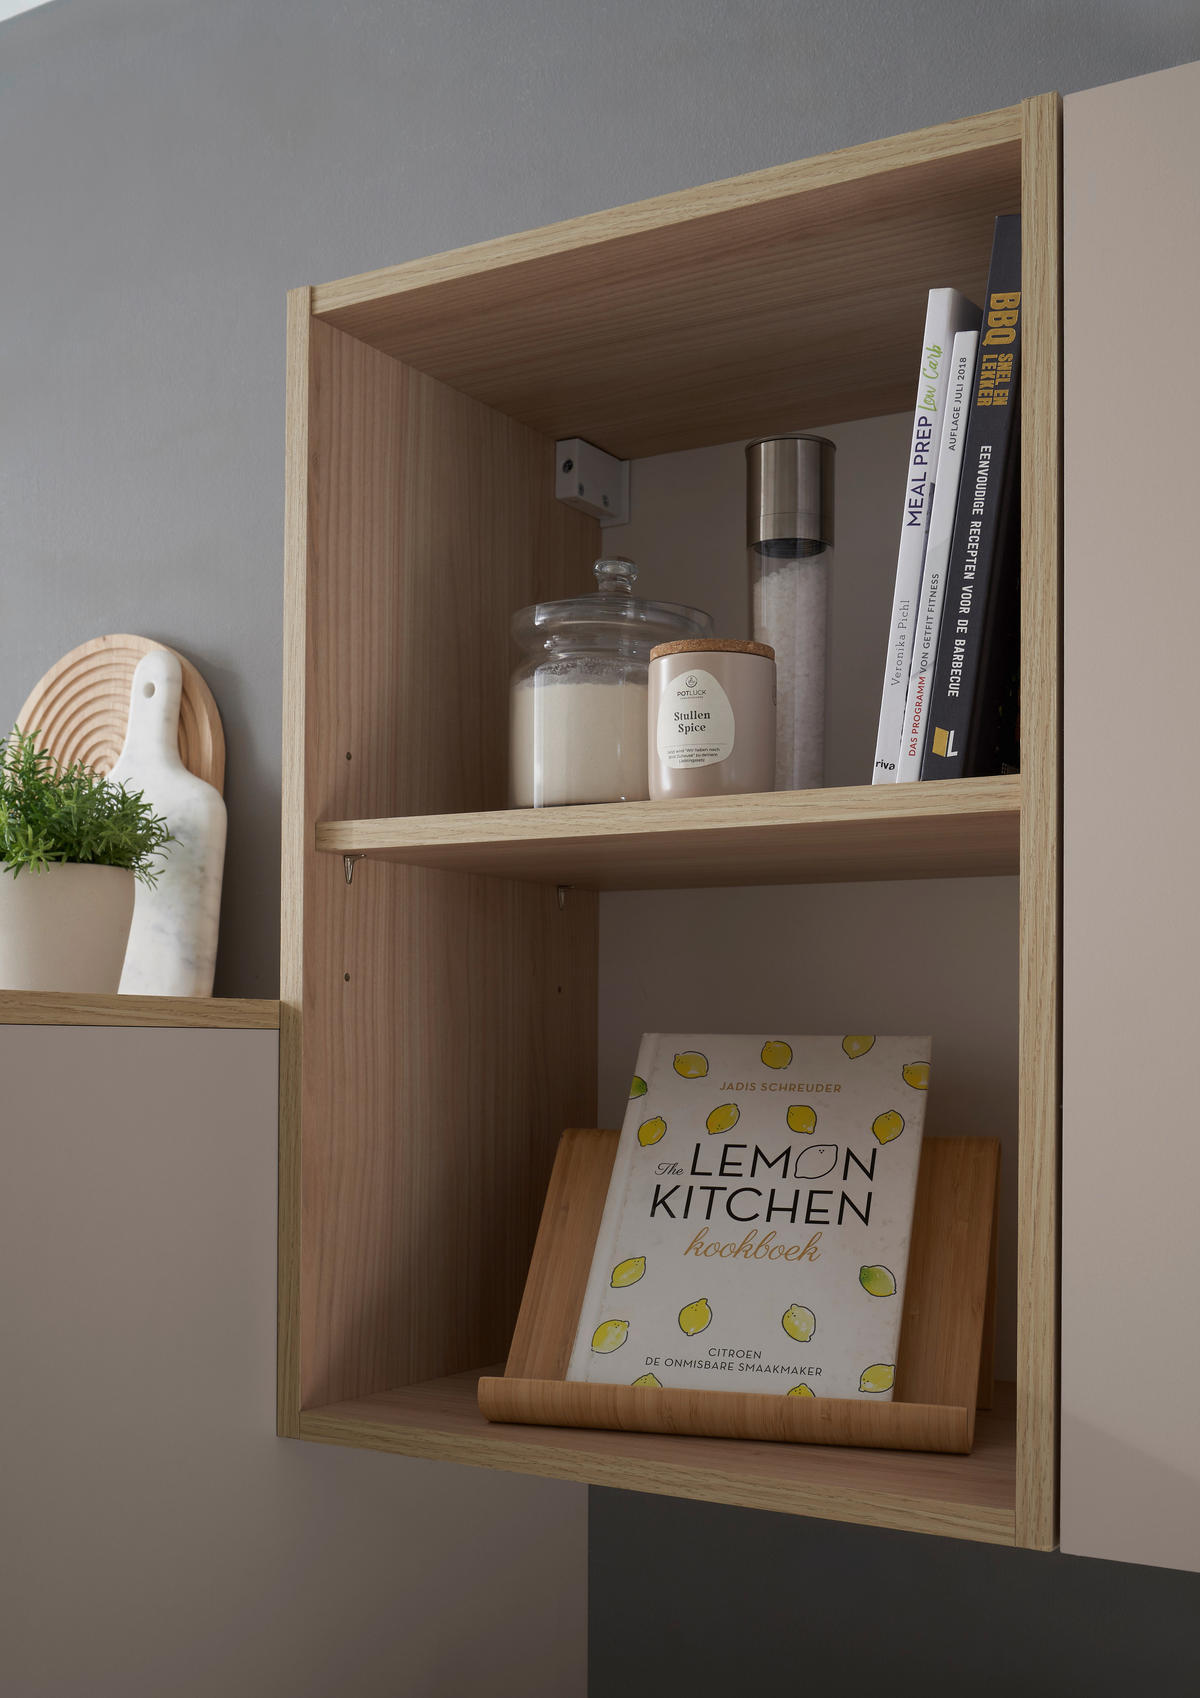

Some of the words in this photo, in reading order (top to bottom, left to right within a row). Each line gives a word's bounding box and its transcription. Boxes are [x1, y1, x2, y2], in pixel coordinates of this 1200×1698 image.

[982, 292, 1021, 346] BBQ
[922, 344, 943, 380] Carb
[957, 357, 967, 380] 2018
[994, 353, 1013, 385] SNEL
[954, 384, 964, 404] JULI
[977, 354, 998, 406] LEKKER
[918, 385, 937, 411] Low
[993, 388, 1009, 406] EN
[913, 416, 932, 465] PREP
[948, 406, 961, 451] AUFLAGE
[972, 445, 992, 515] EENVOUDIGE
[907, 472, 927, 526] MEAL
[963, 521, 982, 580] RECEPTEN
[928, 573, 940, 613] FITNESS
[959, 585, 973, 613] VOOR
[898, 600, 910, 629] Pichl
[956, 619, 969, 634] DE
[922, 615, 934, 649] GETFIT
[891, 634, 906, 686] Veronika
[919, 652, 929, 674] VON
[947, 639, 966, 698] BARBECUE
[677, 689, 707, 697] POTLUCK
[912, 676, 926, 734] PROGRAMM
[674, 710, 711, 721] Stullen
[678, 722, 706, 735] Spice
[908, 736, 918, 757] DAS
[875, 759, 896, 771] riva
[719, 1081, 756, 1092] JADIS
[760, 1082, 842, 1093] SCHREUDER
[654, 1162, 684, 1176] The
[650, 1184, 873, 1226] KITCHEN
[684, 1226, 823, 1262] kookboek
[645, 1356, 660, 1367] DE
[664, 1358, 734, 1372] ONMISBARE
[738, 1362, 823, 1377] SMAAKMAKER
[708, 1347, 762, 1360] CITROEN
